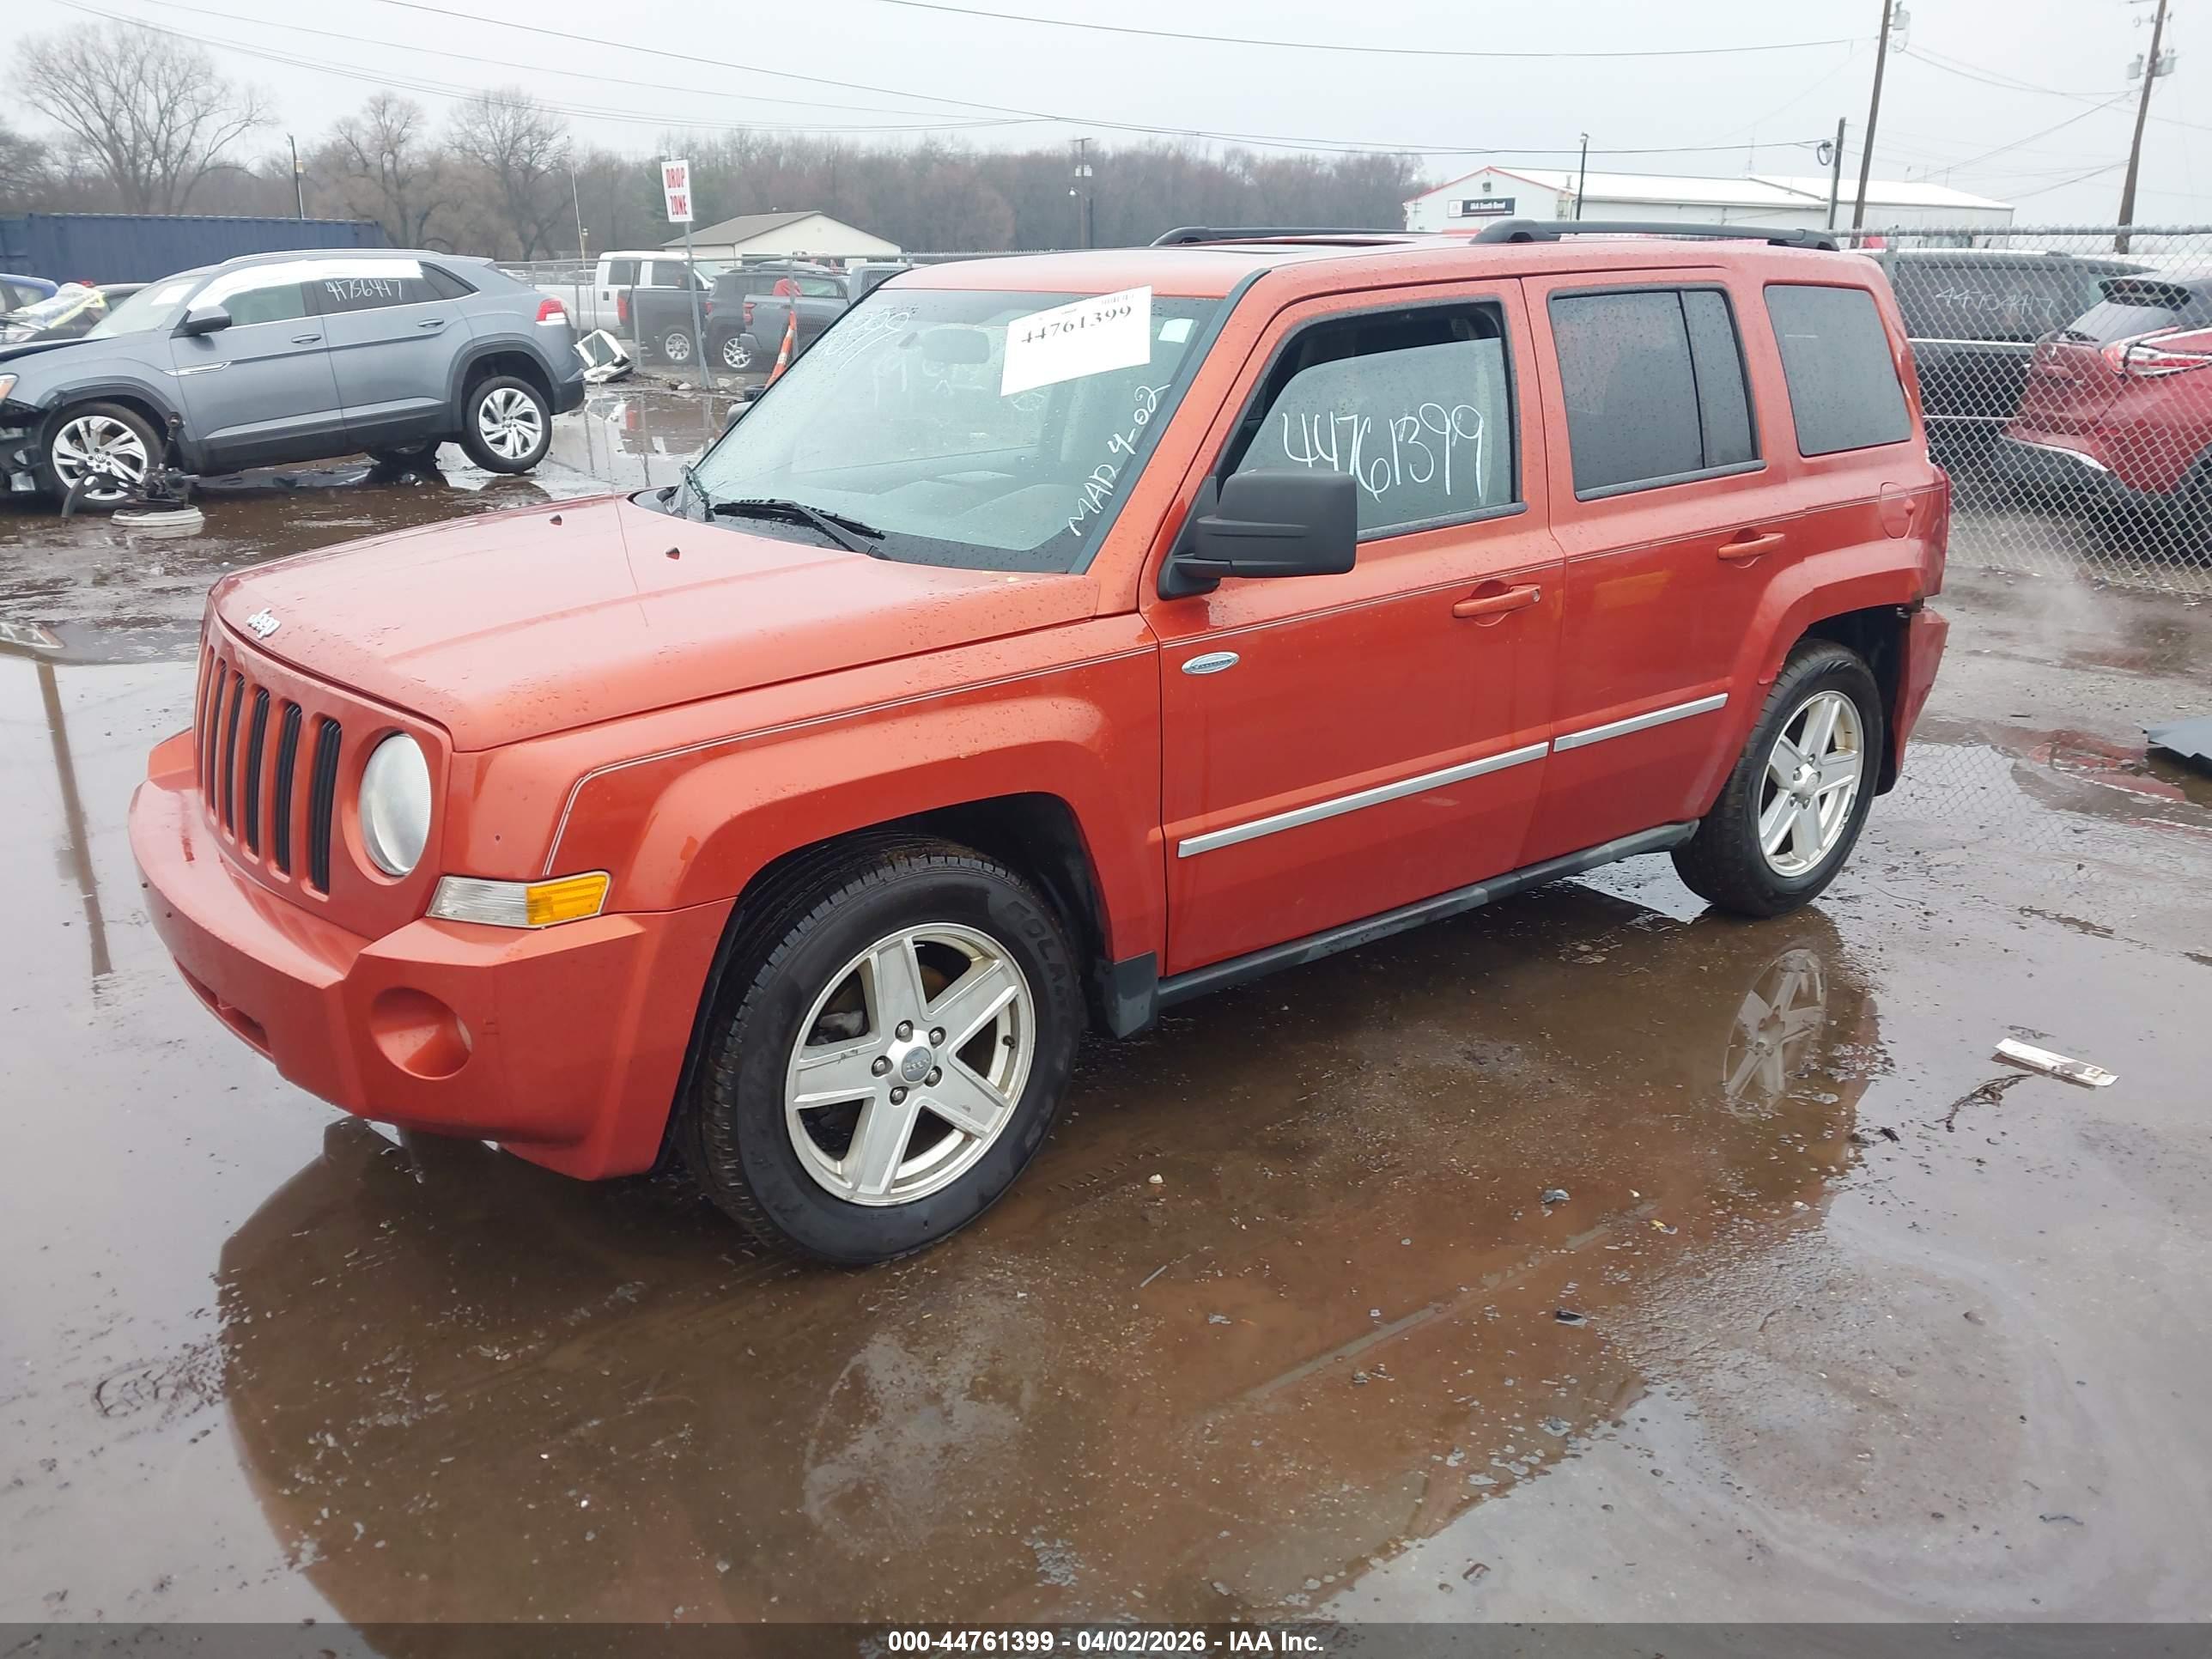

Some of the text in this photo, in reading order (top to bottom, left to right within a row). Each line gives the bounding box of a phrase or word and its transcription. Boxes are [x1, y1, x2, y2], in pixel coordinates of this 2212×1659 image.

[666, 167, 684, 188] DROP
[670, 194, 688, 216] ZONE
[1020, 304, 1133, 344] 44761399
[1106, 383, 1172, 455] 4-02
[1282, 402, 1485, 503] 44761399
[246, 607, 282, 640] Jeep
